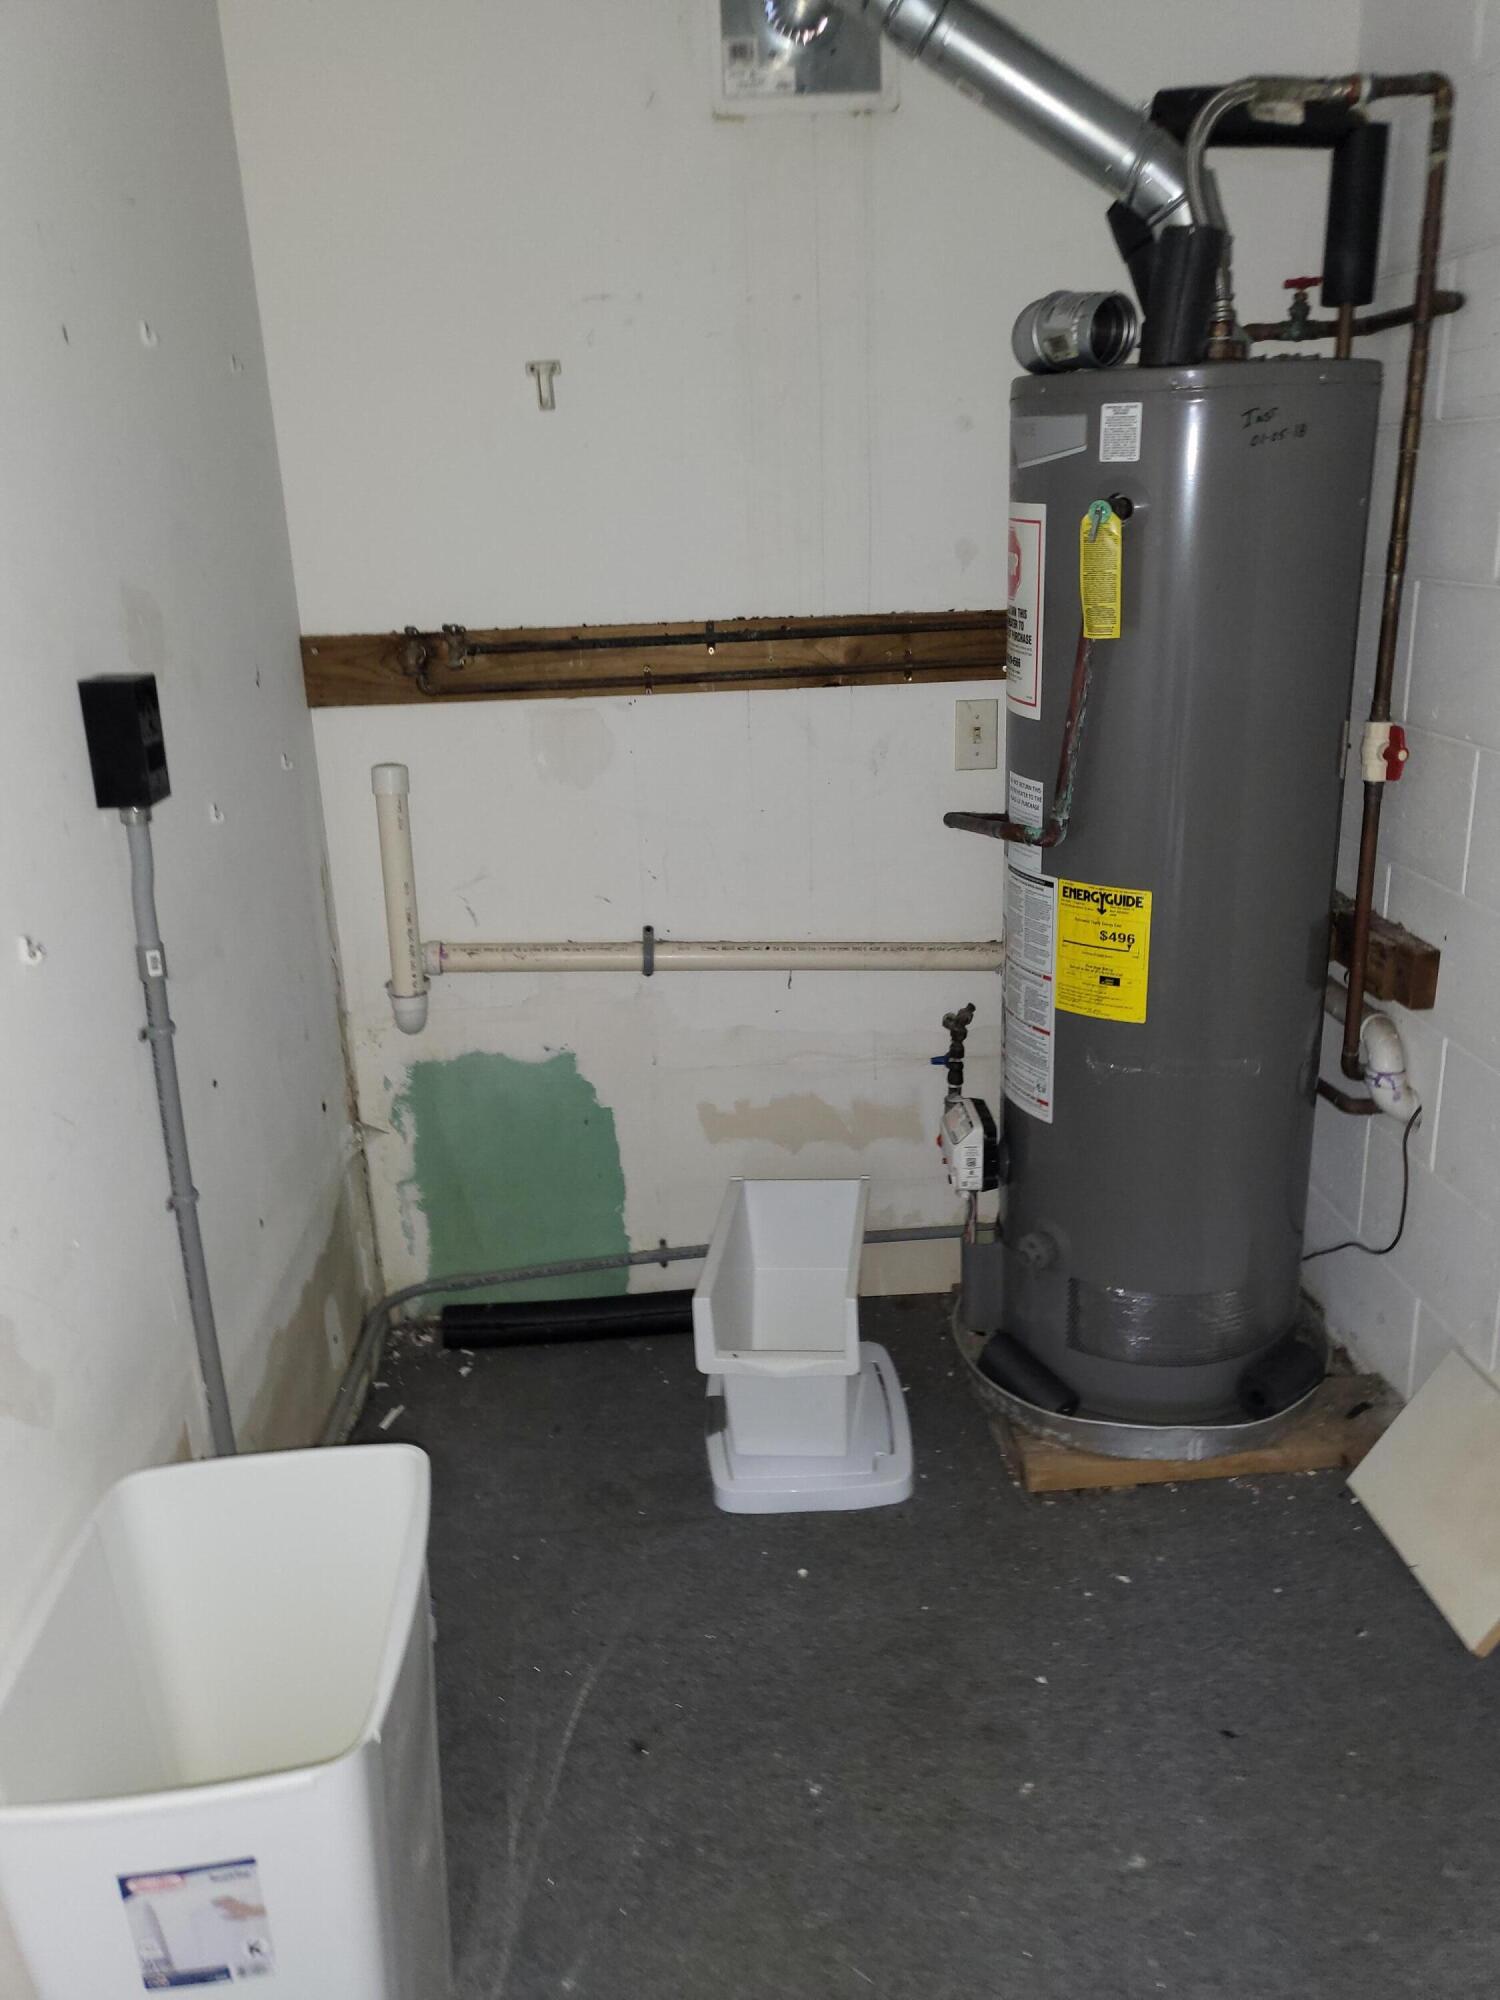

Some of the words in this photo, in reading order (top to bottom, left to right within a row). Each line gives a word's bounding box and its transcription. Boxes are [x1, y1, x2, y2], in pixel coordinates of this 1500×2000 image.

[1018, 620, 1025, 631] TO
[1062, 886, 1144, 910] ENERGYGUIDE
[1099, 929, 1136, 944] $496
